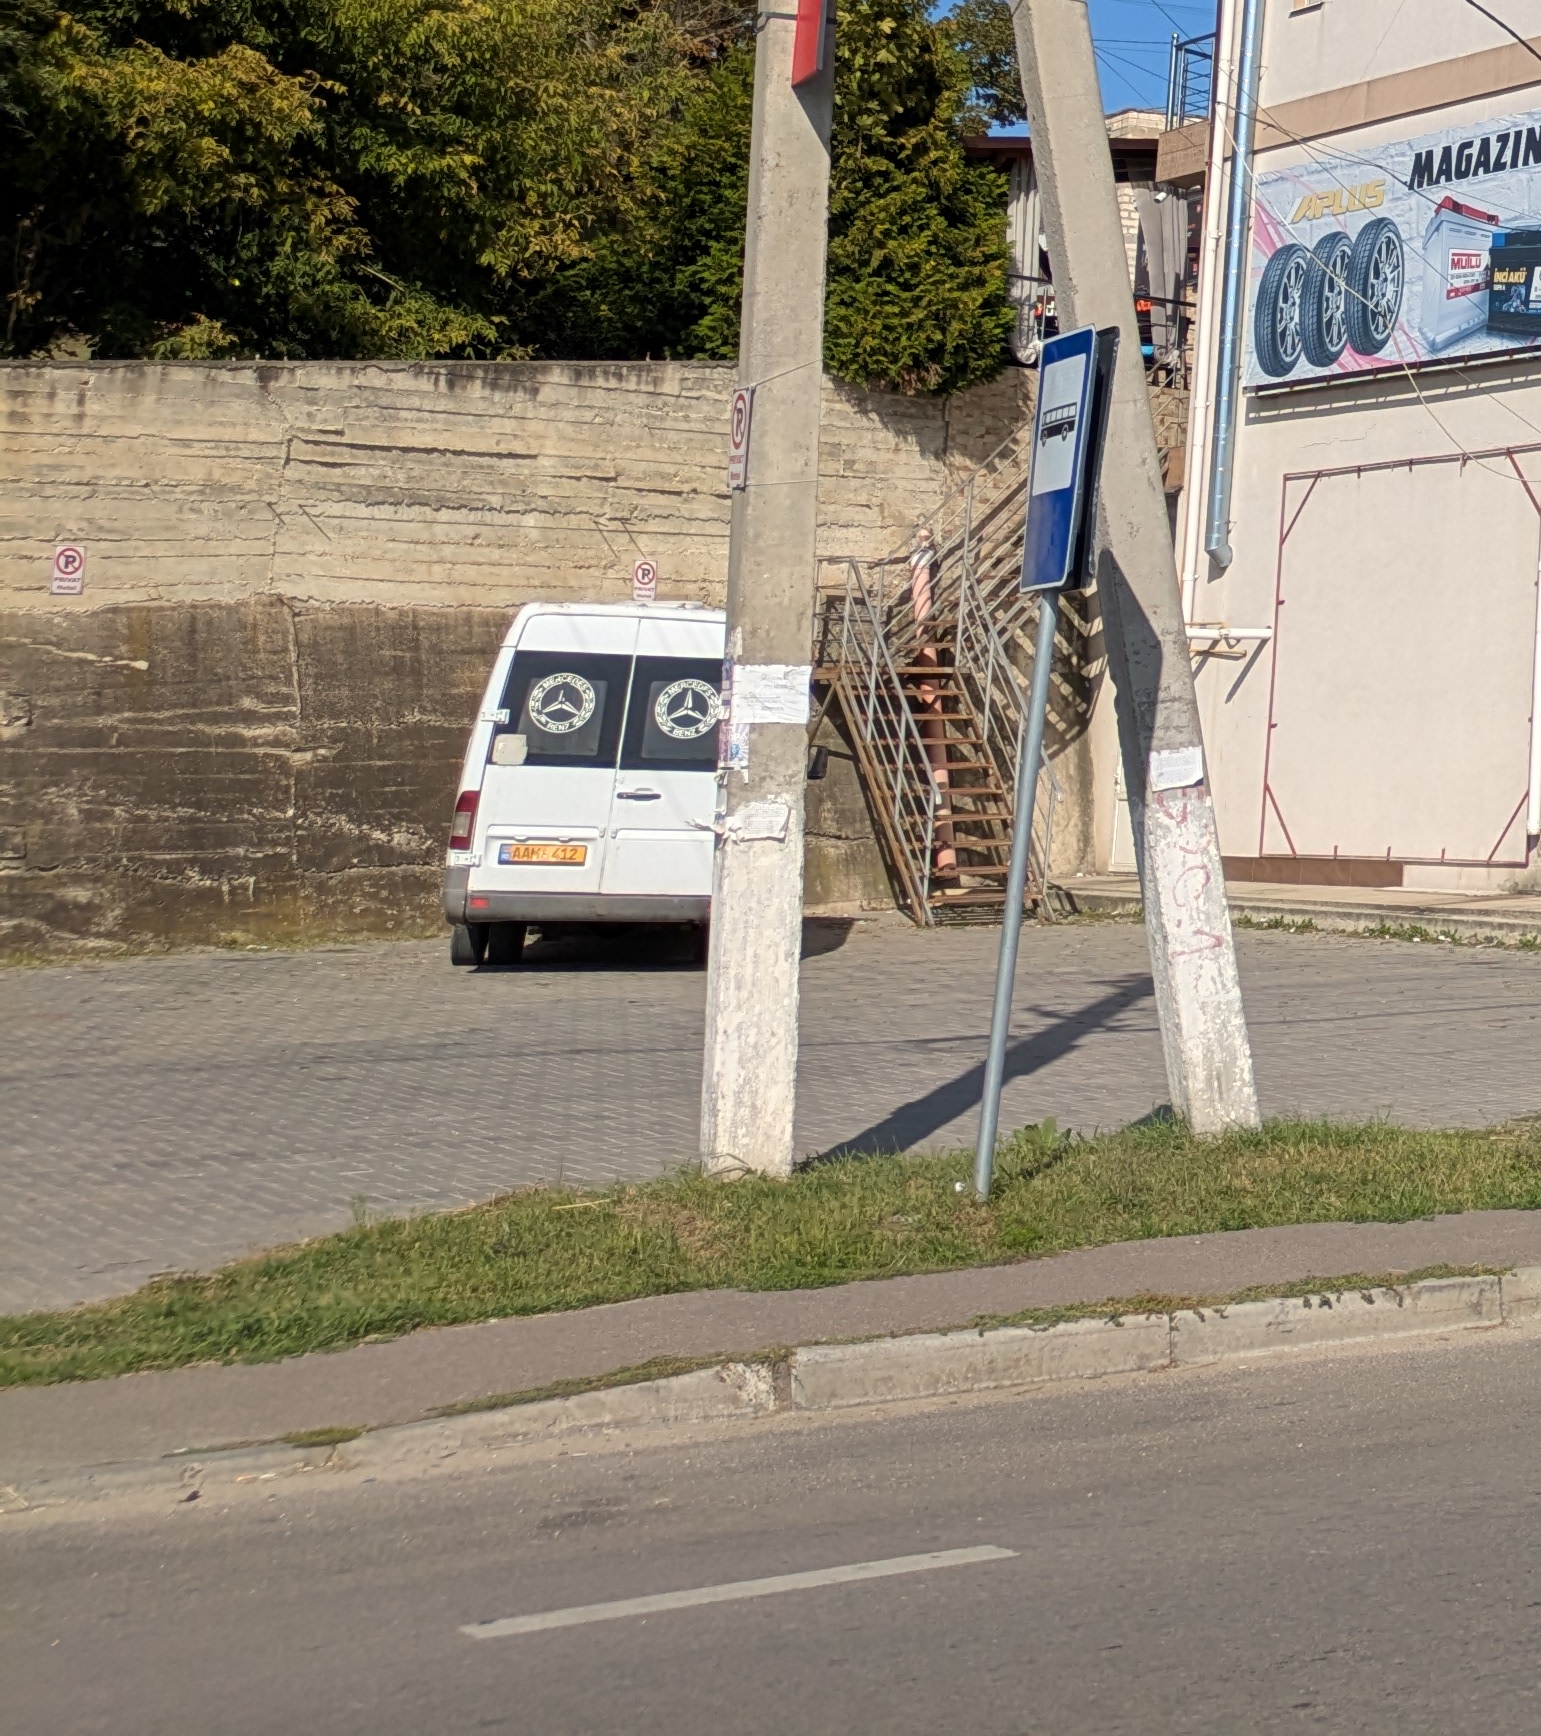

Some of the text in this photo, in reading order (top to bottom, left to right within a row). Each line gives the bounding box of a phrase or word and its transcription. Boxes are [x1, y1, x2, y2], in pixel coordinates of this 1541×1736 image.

[1290, 179, 1386, 225] APLUS
[542, 673, 589, 692] MERCEDES
[668, 679, 714, 696] MERCEDES
[673, 727, 697, 738] BENZ
